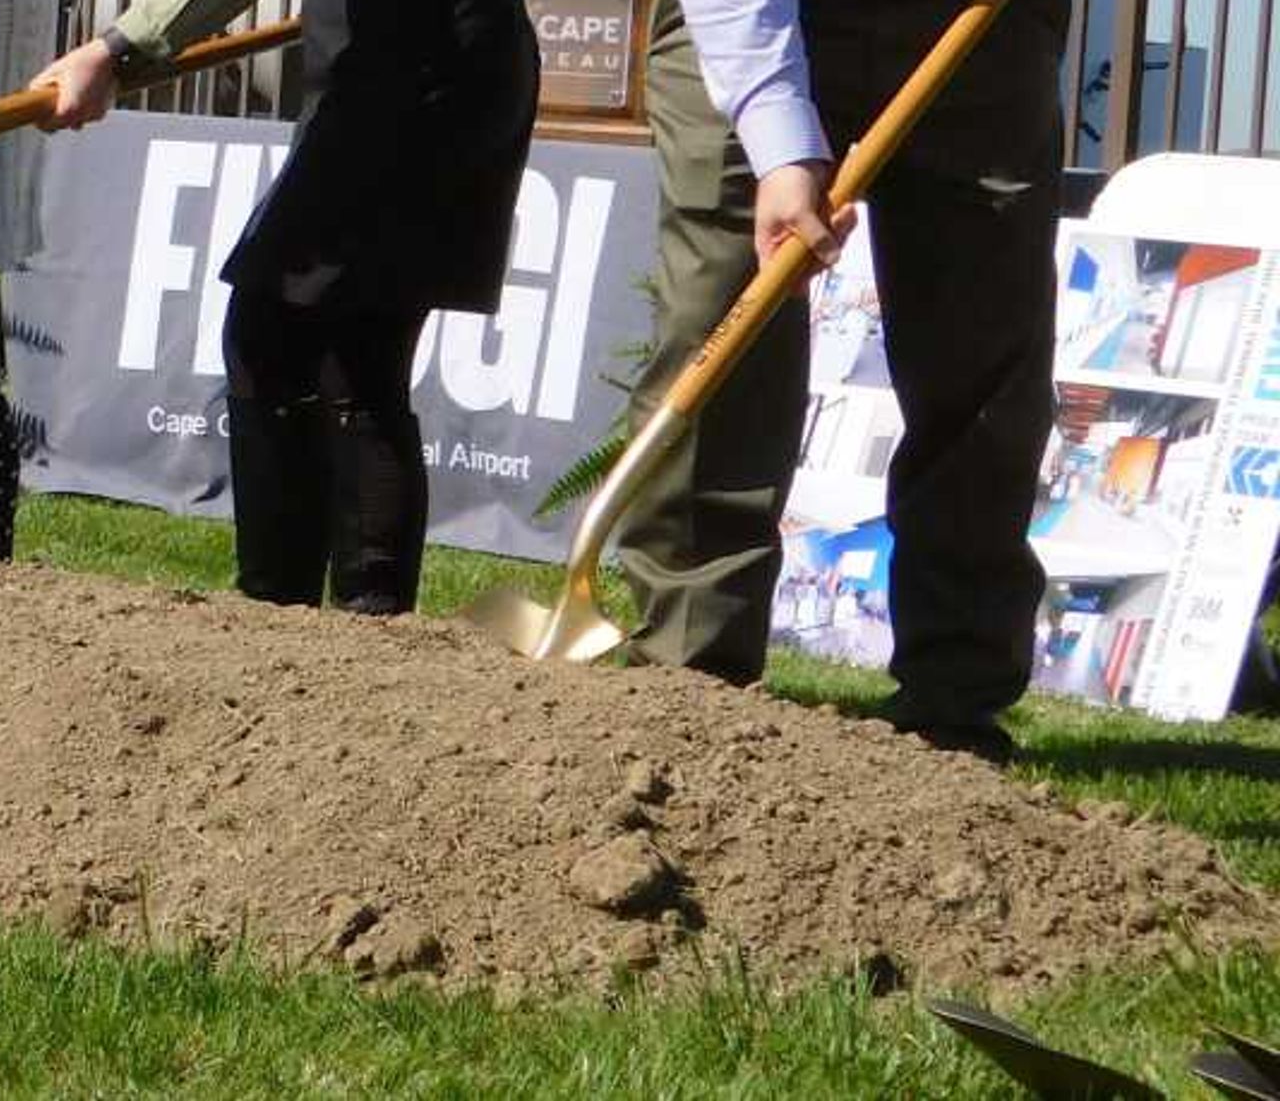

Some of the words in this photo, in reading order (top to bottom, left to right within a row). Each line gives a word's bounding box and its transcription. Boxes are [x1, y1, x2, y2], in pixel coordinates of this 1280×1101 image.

[538, 15, 621, 43] CAPE
[147, 405, 207, 438] Cape
[449, 442, 532, 481] Airport
